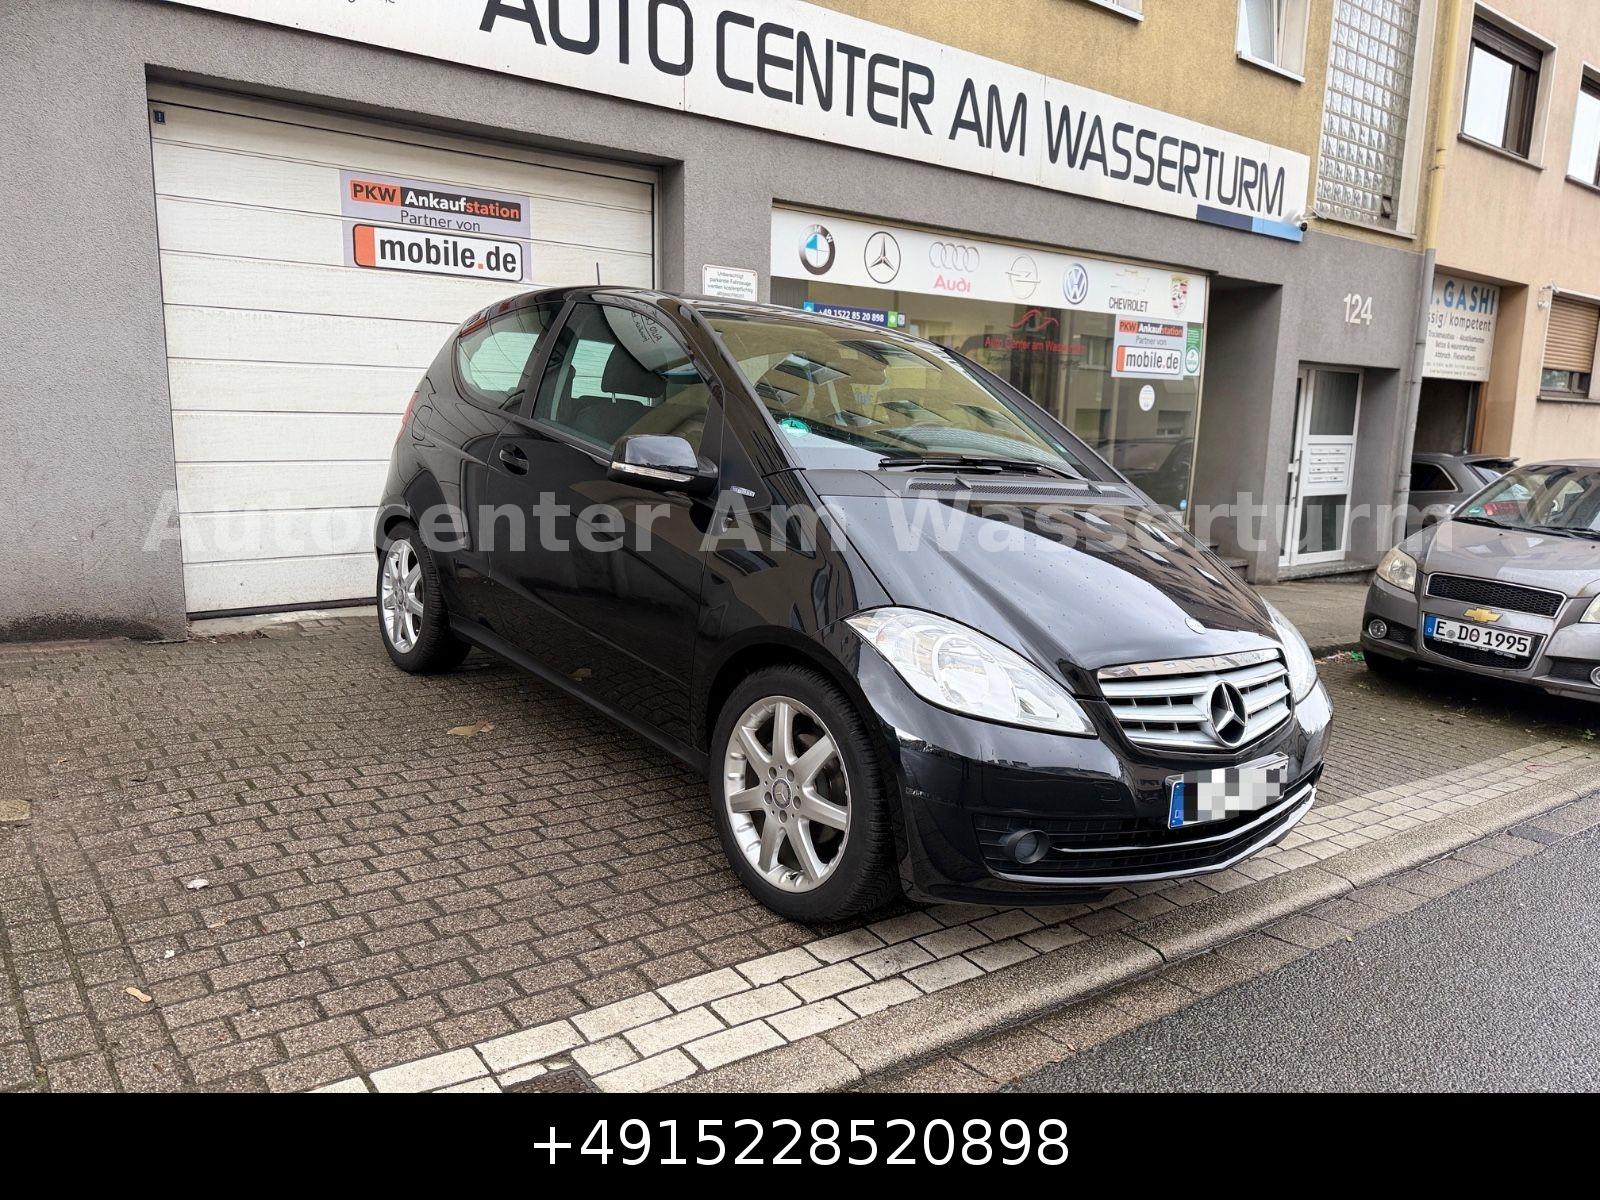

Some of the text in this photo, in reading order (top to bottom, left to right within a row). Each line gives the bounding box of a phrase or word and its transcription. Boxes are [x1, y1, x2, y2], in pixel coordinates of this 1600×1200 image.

[480, 0, 1285, 217] AUTO CENTER AM WASSERTURM
[352, 182, 520, 220] PKW Ankaufstation
[400, 209, 481, 232] Partner von
[379, 236, 517, 273] mobile.de
[933, 274, 971, 293] Audi
[1108, 296, 1149, 313] CHEVROLET
[1343, 293, 1373, 326] 124
[851, 312, 860, 320] 85
[862, 313, 871, 321] 20
[871, 313, 885, 323] 898
[1119, 321, 1137, 331] PKW
[1448, 311, 1491, 332] kompetent
[1135, 336, 1167, 346] Partner von
[1125, 351, 1179, 370] mobile.de
[1435, 620, 1447, 637] E
[1483, 631, 1529, 653] 1995
